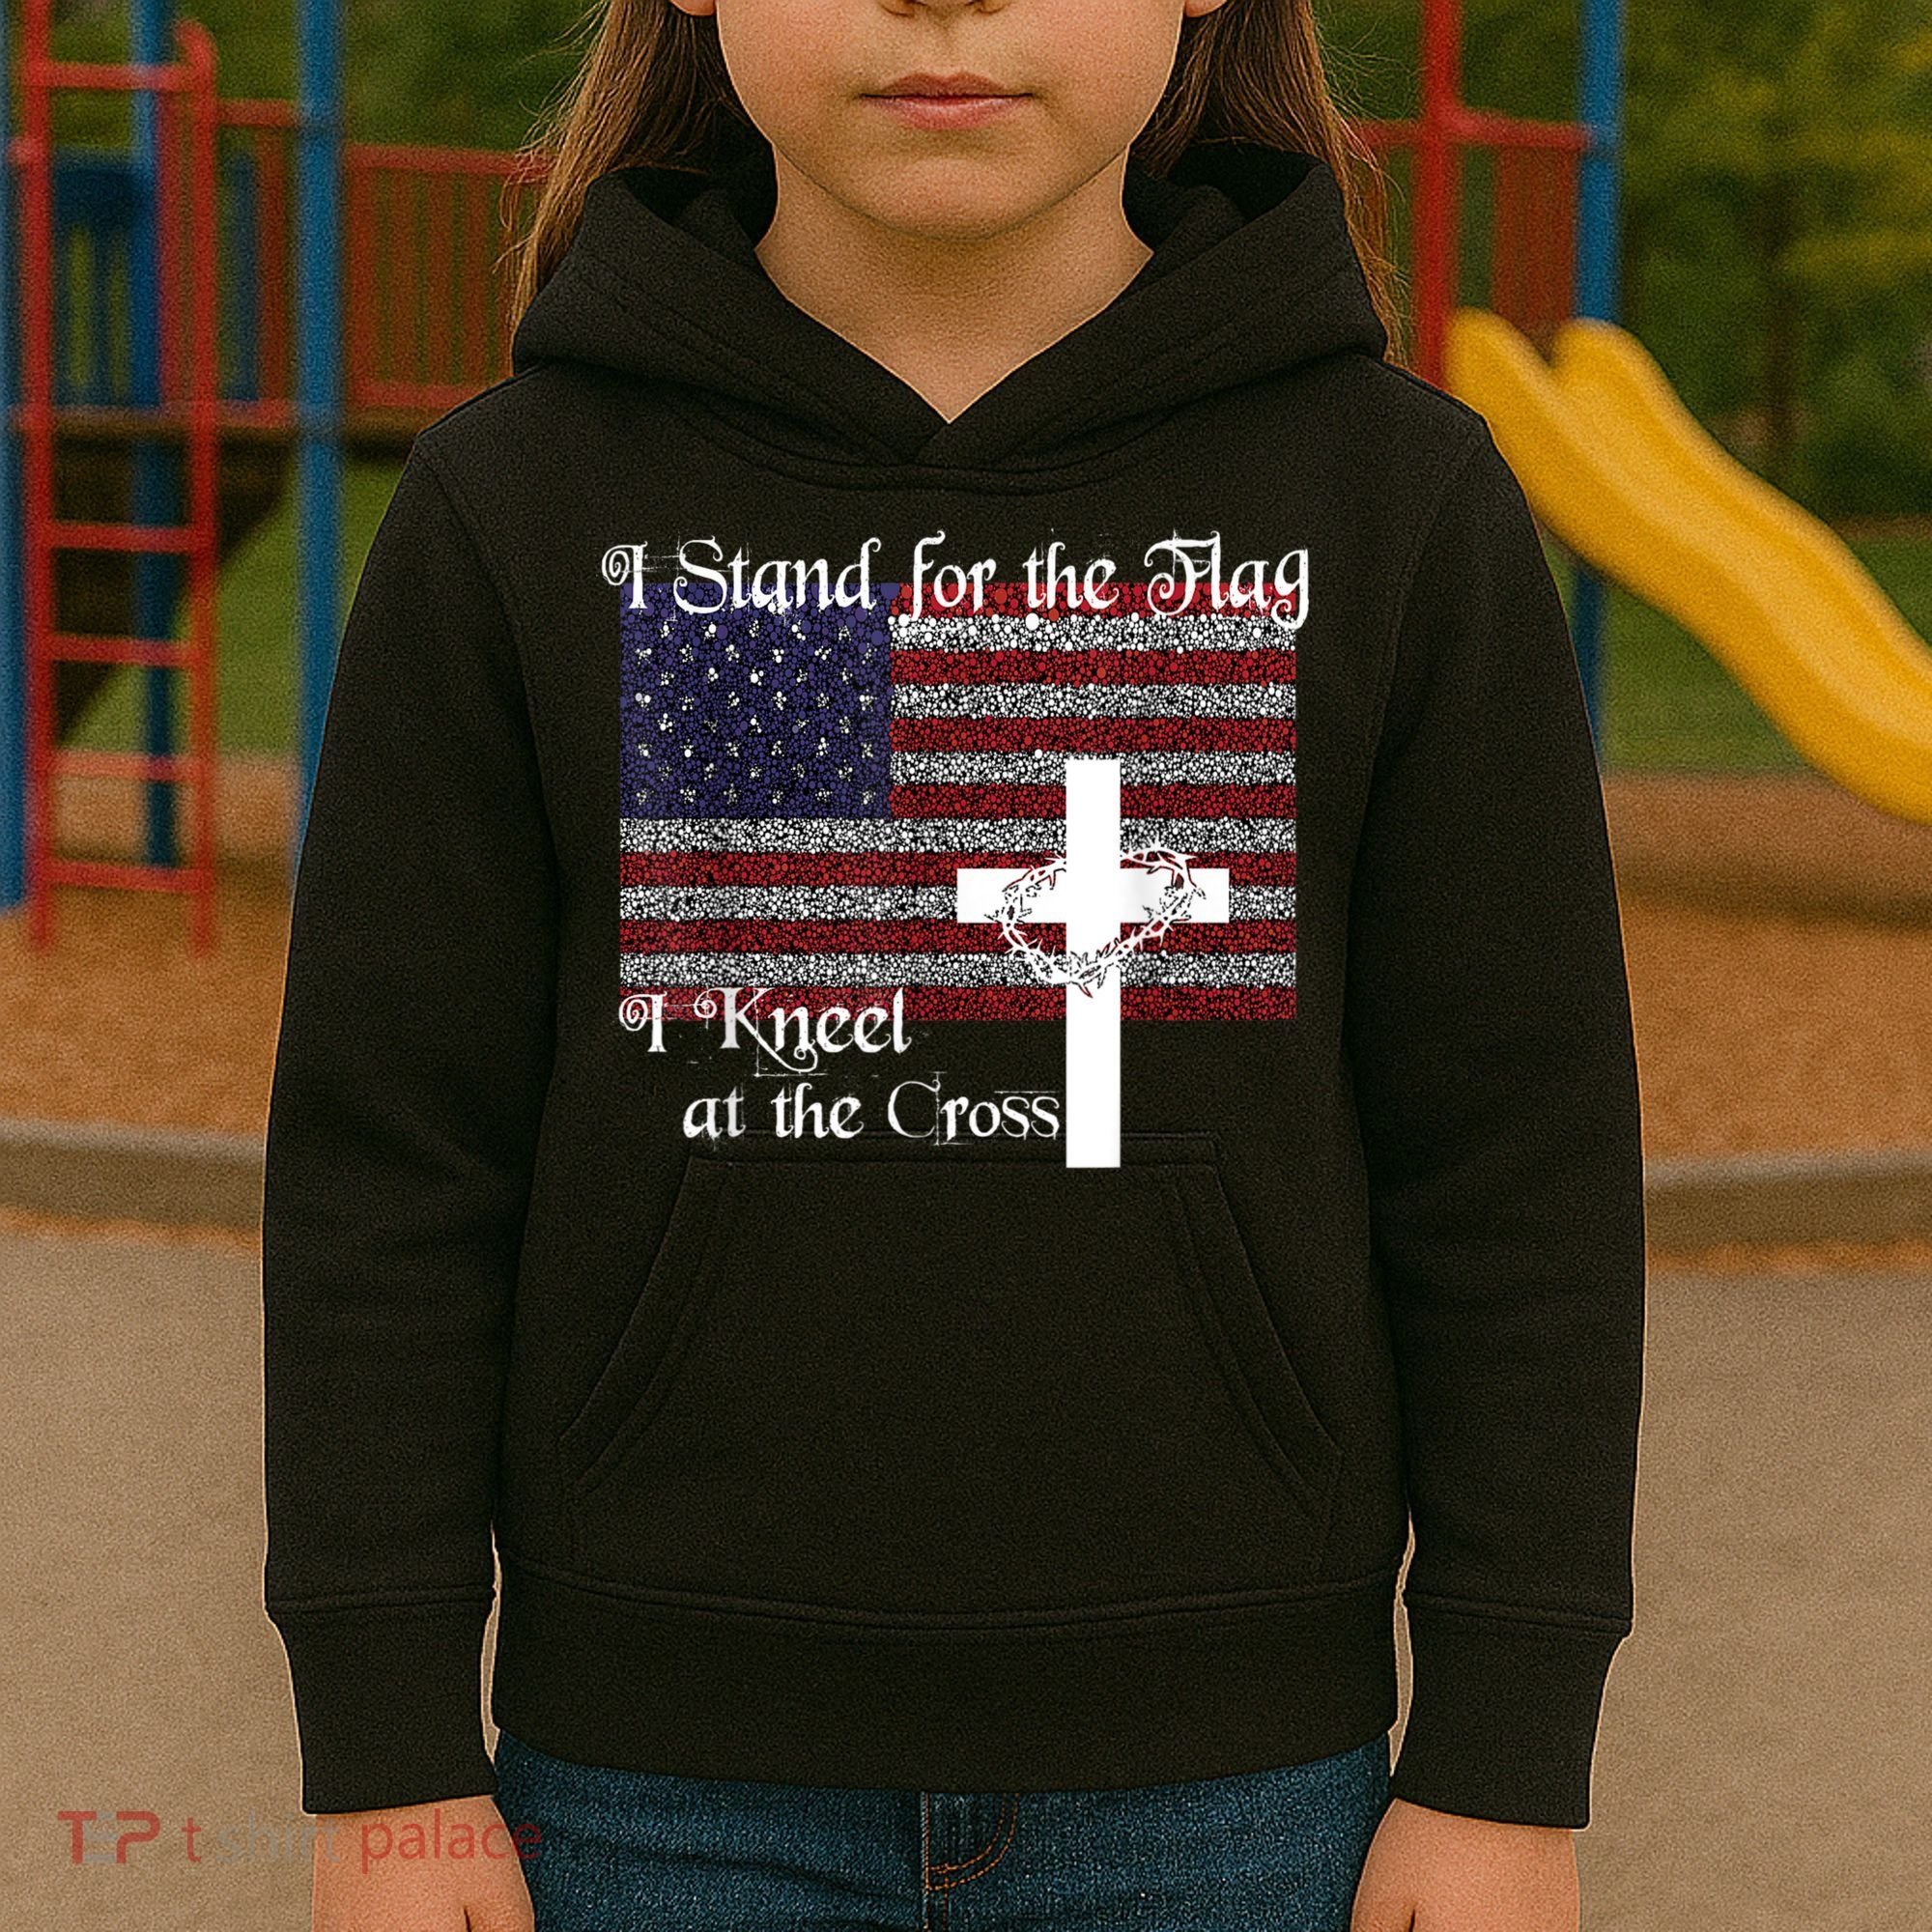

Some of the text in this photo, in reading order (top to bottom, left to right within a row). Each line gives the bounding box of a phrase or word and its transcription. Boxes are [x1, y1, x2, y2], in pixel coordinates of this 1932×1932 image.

[601, 530, 1309, 631] I Stand for the Flag
[618, 986, 912, 1073] I Kneel
[682, 1079, 1060, 1143] at the Cross
